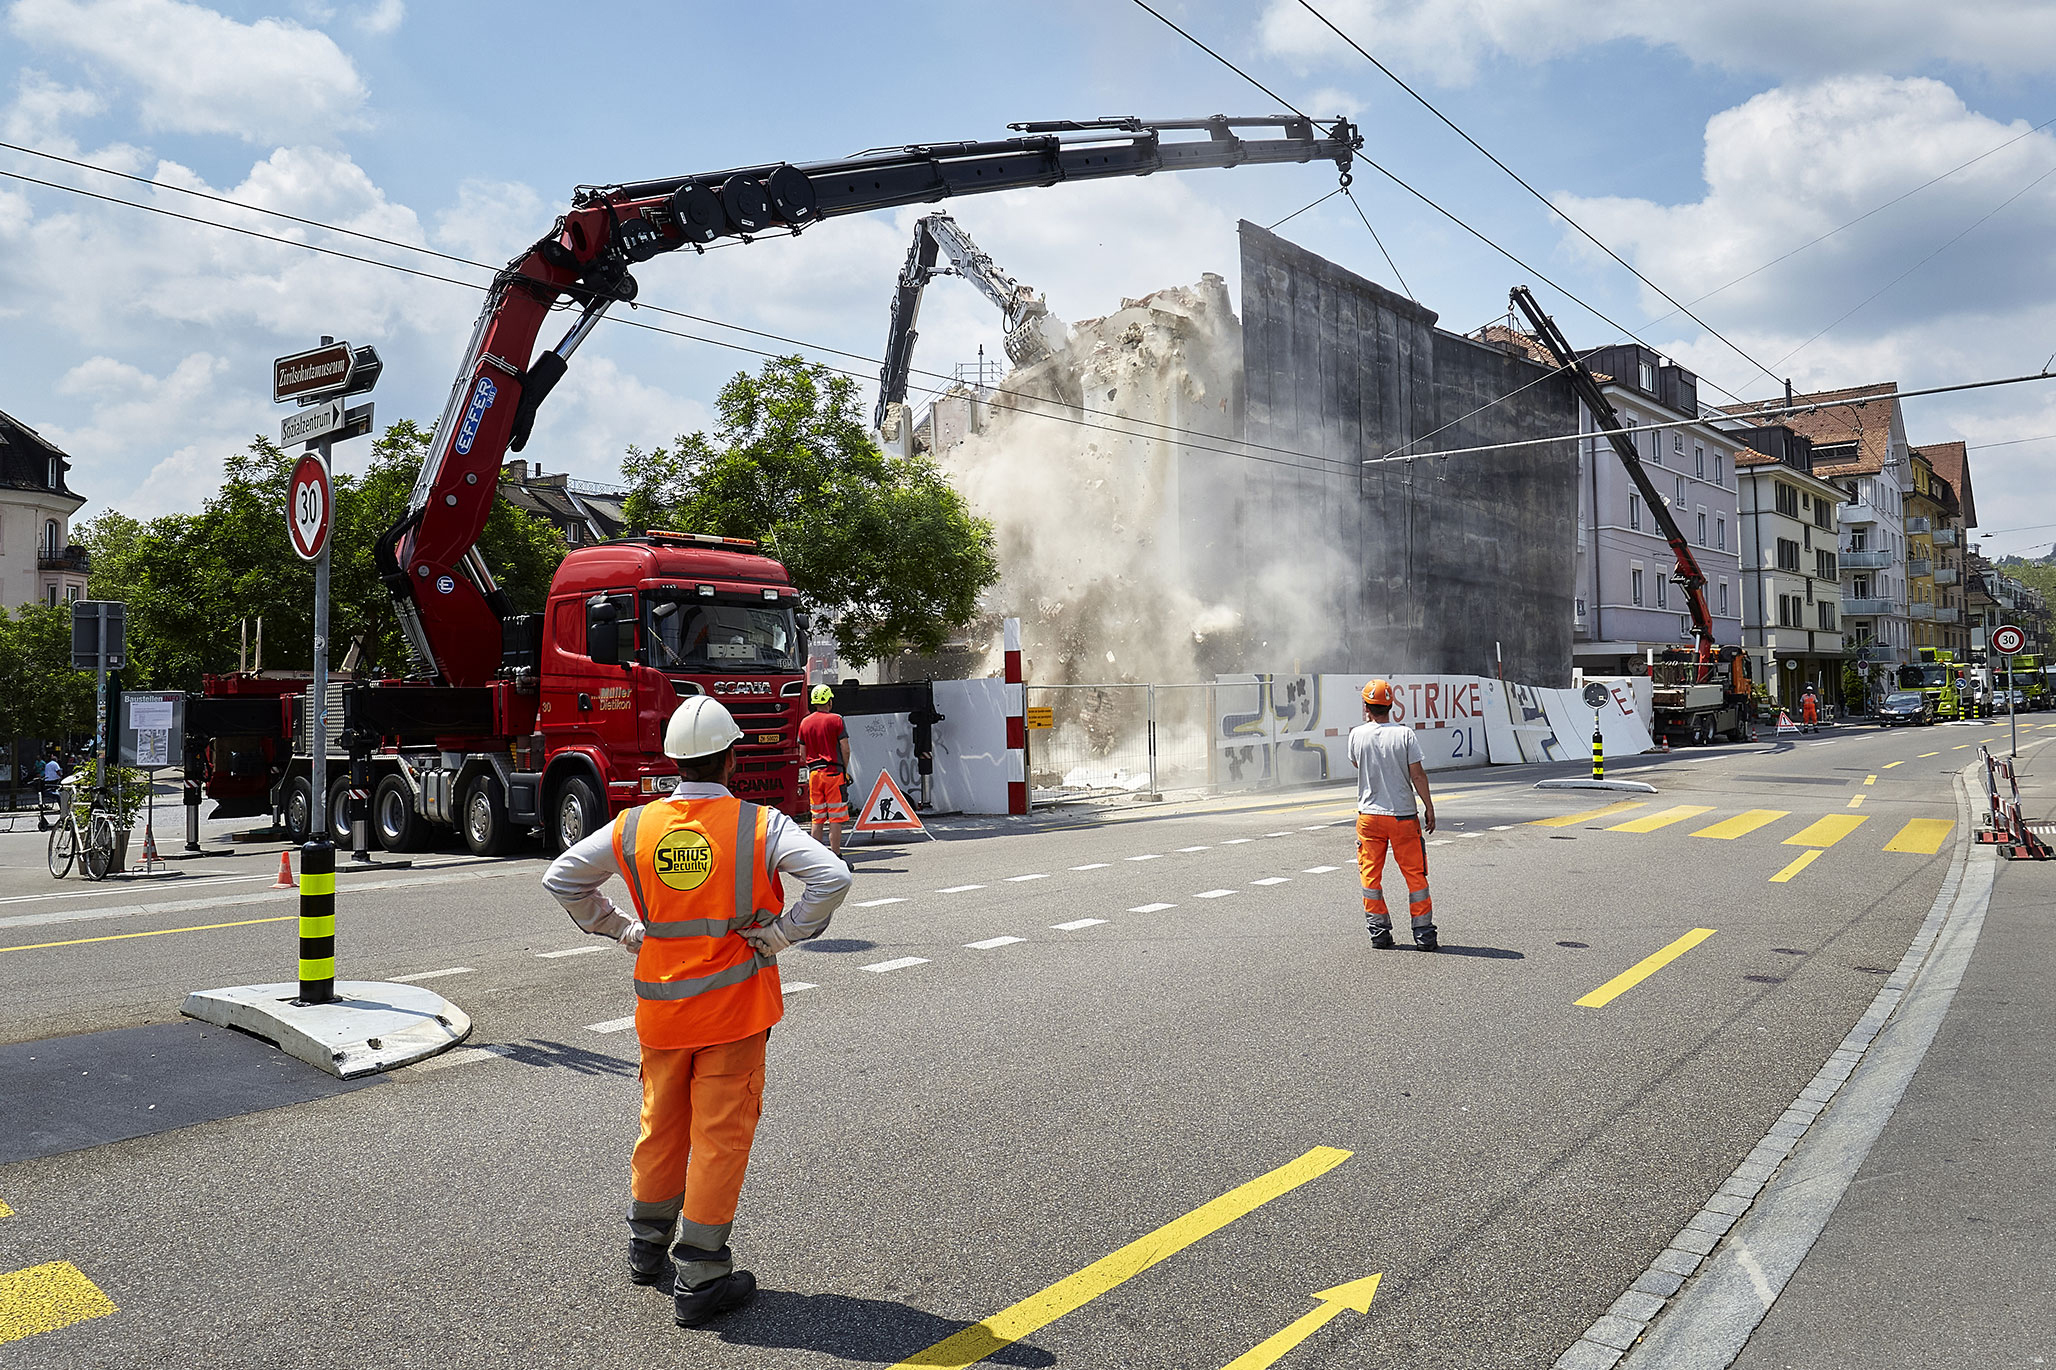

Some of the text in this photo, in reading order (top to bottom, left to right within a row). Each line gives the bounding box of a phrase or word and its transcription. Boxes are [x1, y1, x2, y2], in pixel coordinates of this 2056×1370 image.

[279, 359, 345, 387] Zivilschutzmuseum
[459, 380, 491, 449] EFFER
[282, 410, 331, 441] Sozialzentrum
[301, 488, 317, 525] 30
[2002, 635, 2015, 645] 30
[713, 681, 772, 695] SCANIA
[124, 695, 163, 703] Baustellen
[542, 701, 552, 712] 30
[1452, 727, 1473, 758] 21
[728, 778, 785, 793] SCANIA
